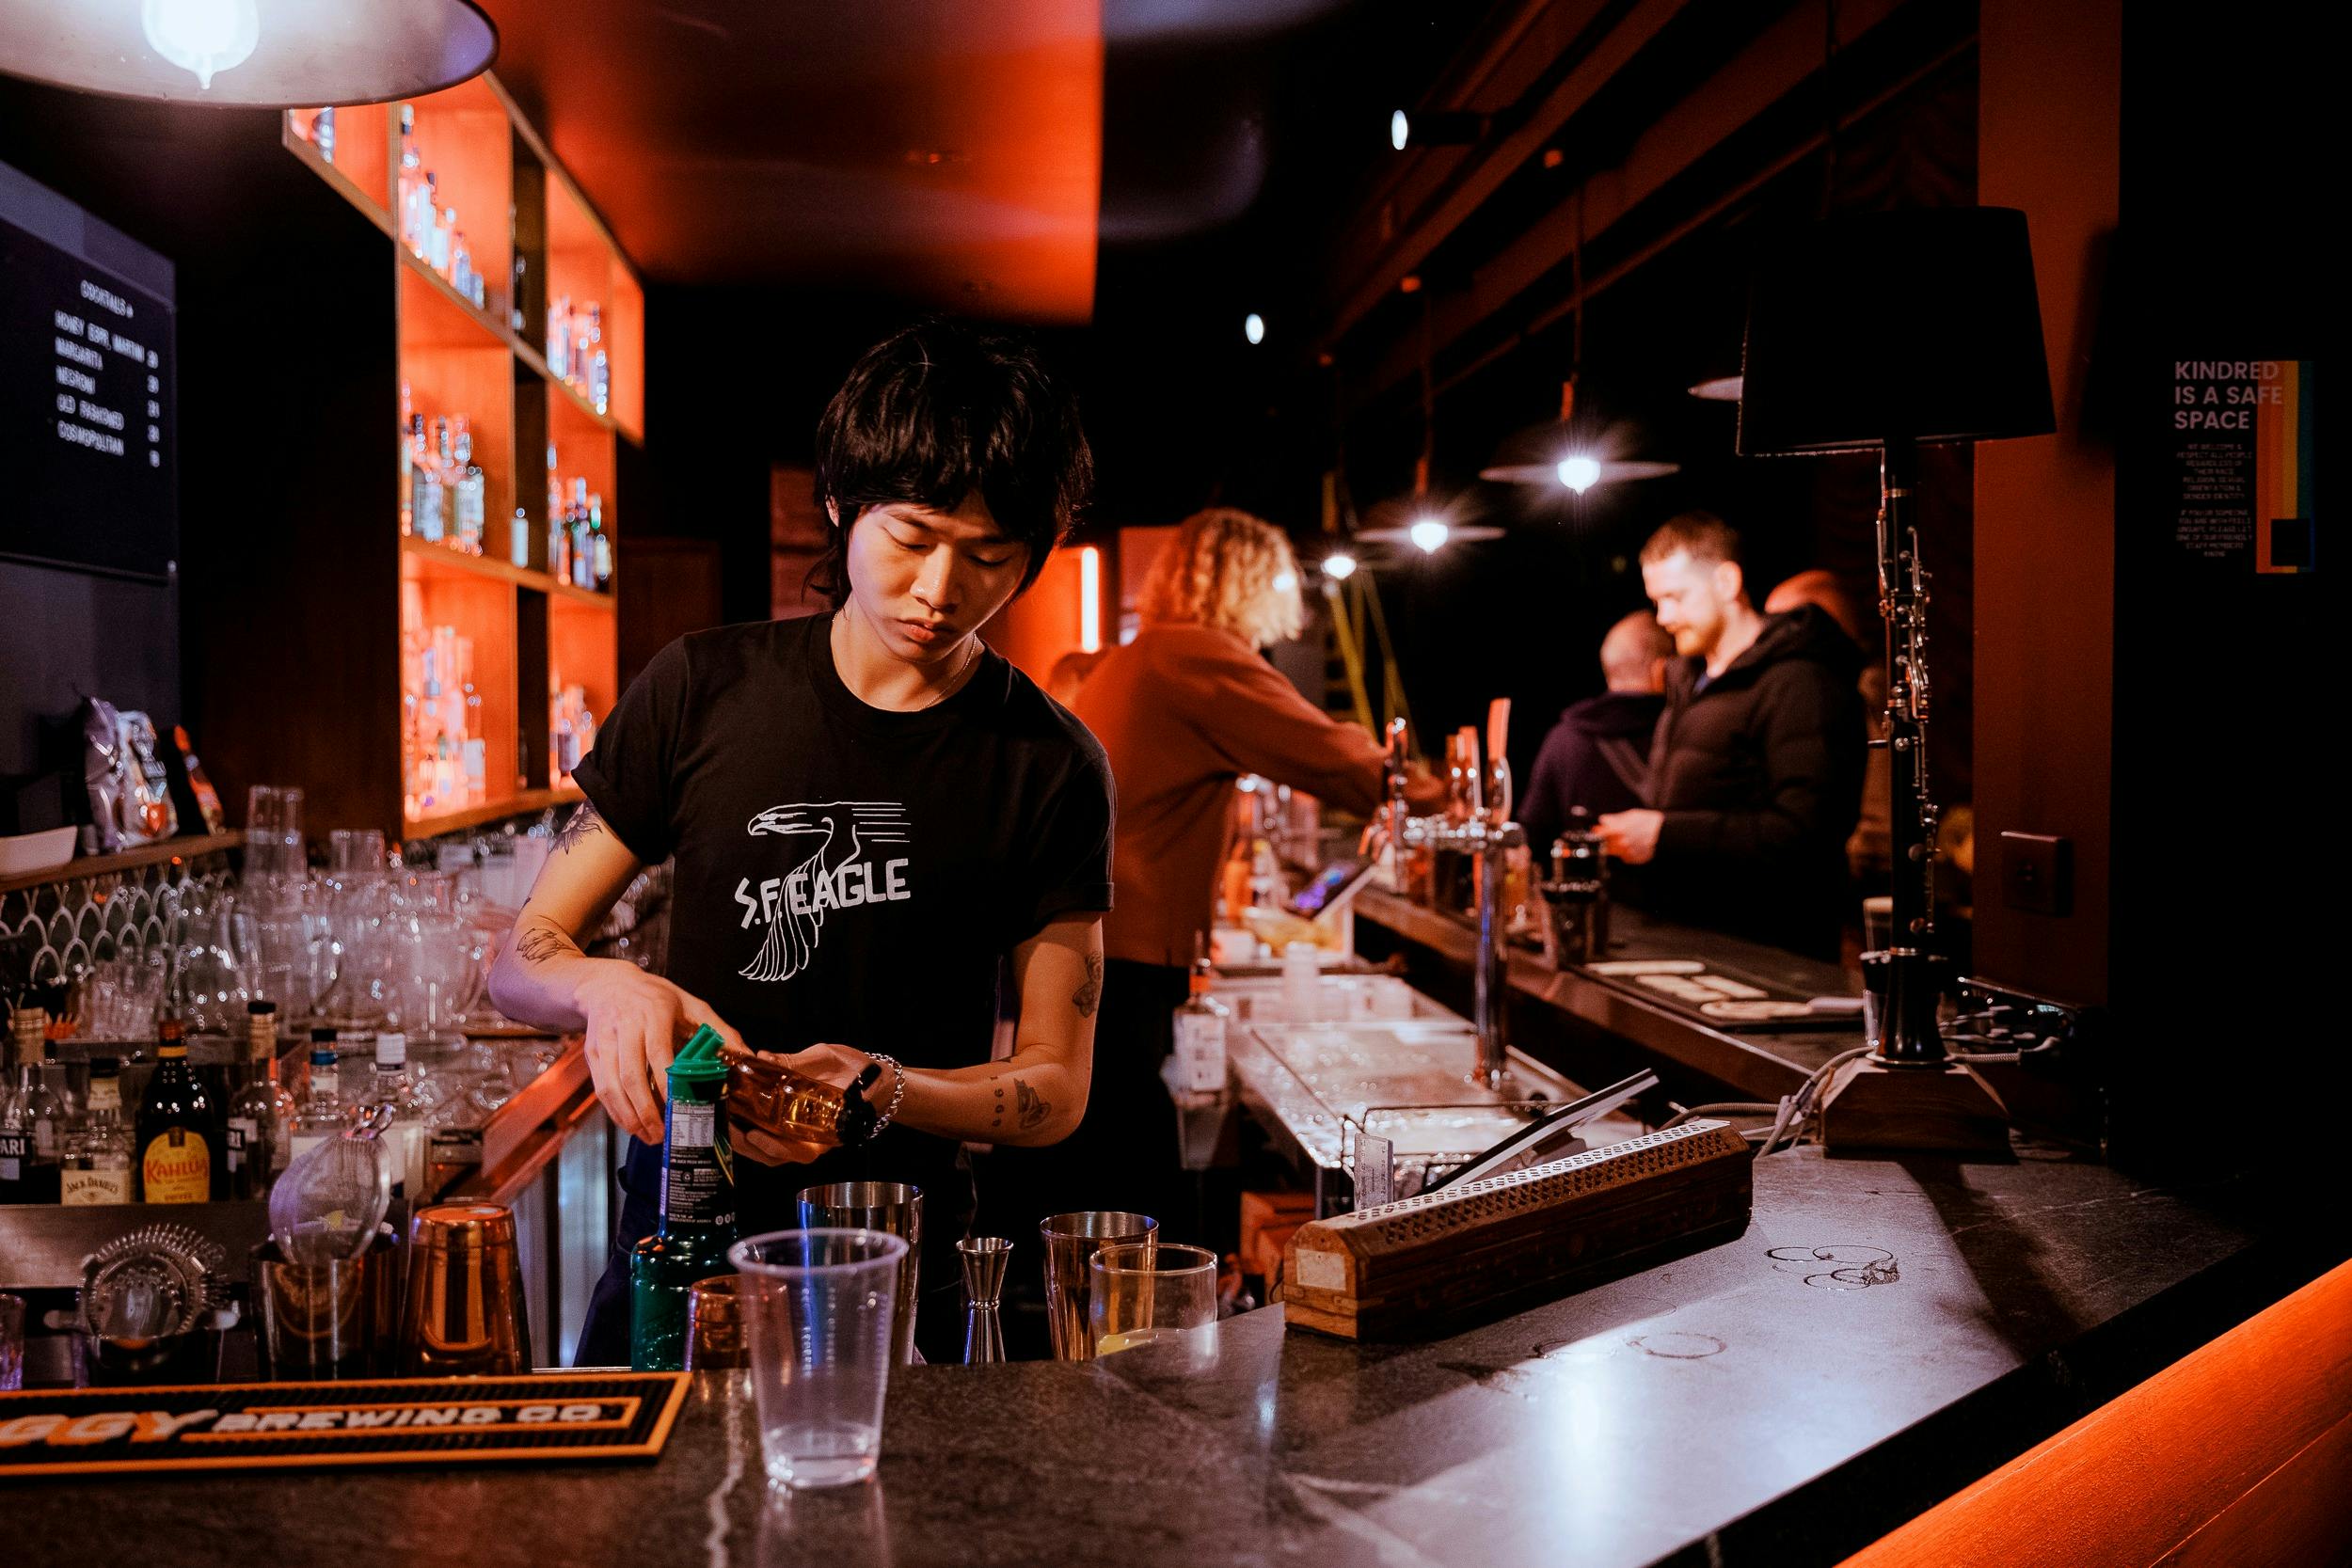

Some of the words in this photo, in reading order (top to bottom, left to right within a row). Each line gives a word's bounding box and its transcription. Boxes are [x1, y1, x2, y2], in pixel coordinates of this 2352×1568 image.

[80, 279, 127, 316] COCKTAILS
[55, 309, 85, 337] HONEY
[111, 334, 145, 363] MARTINI
[56, 365, 96, 395] NEGRONI
[2175, 361, 2279, 380] KINDRED
[56, 393, 76, 415] OLD
[79, 400, 124, 431] FASHIONED
[2175, 387, 2196, 404] IS
[2202, 387, 2219, 404] A
[2227, 387, 2282, 404] SAFE
[2174, 411, 2250, 430] SPACE
[57, 420, 124, 456] COSMOPOLITAN
[787, 858, 911, 915] EAGLE
[212, 1407, 502, 1433] BREWING
